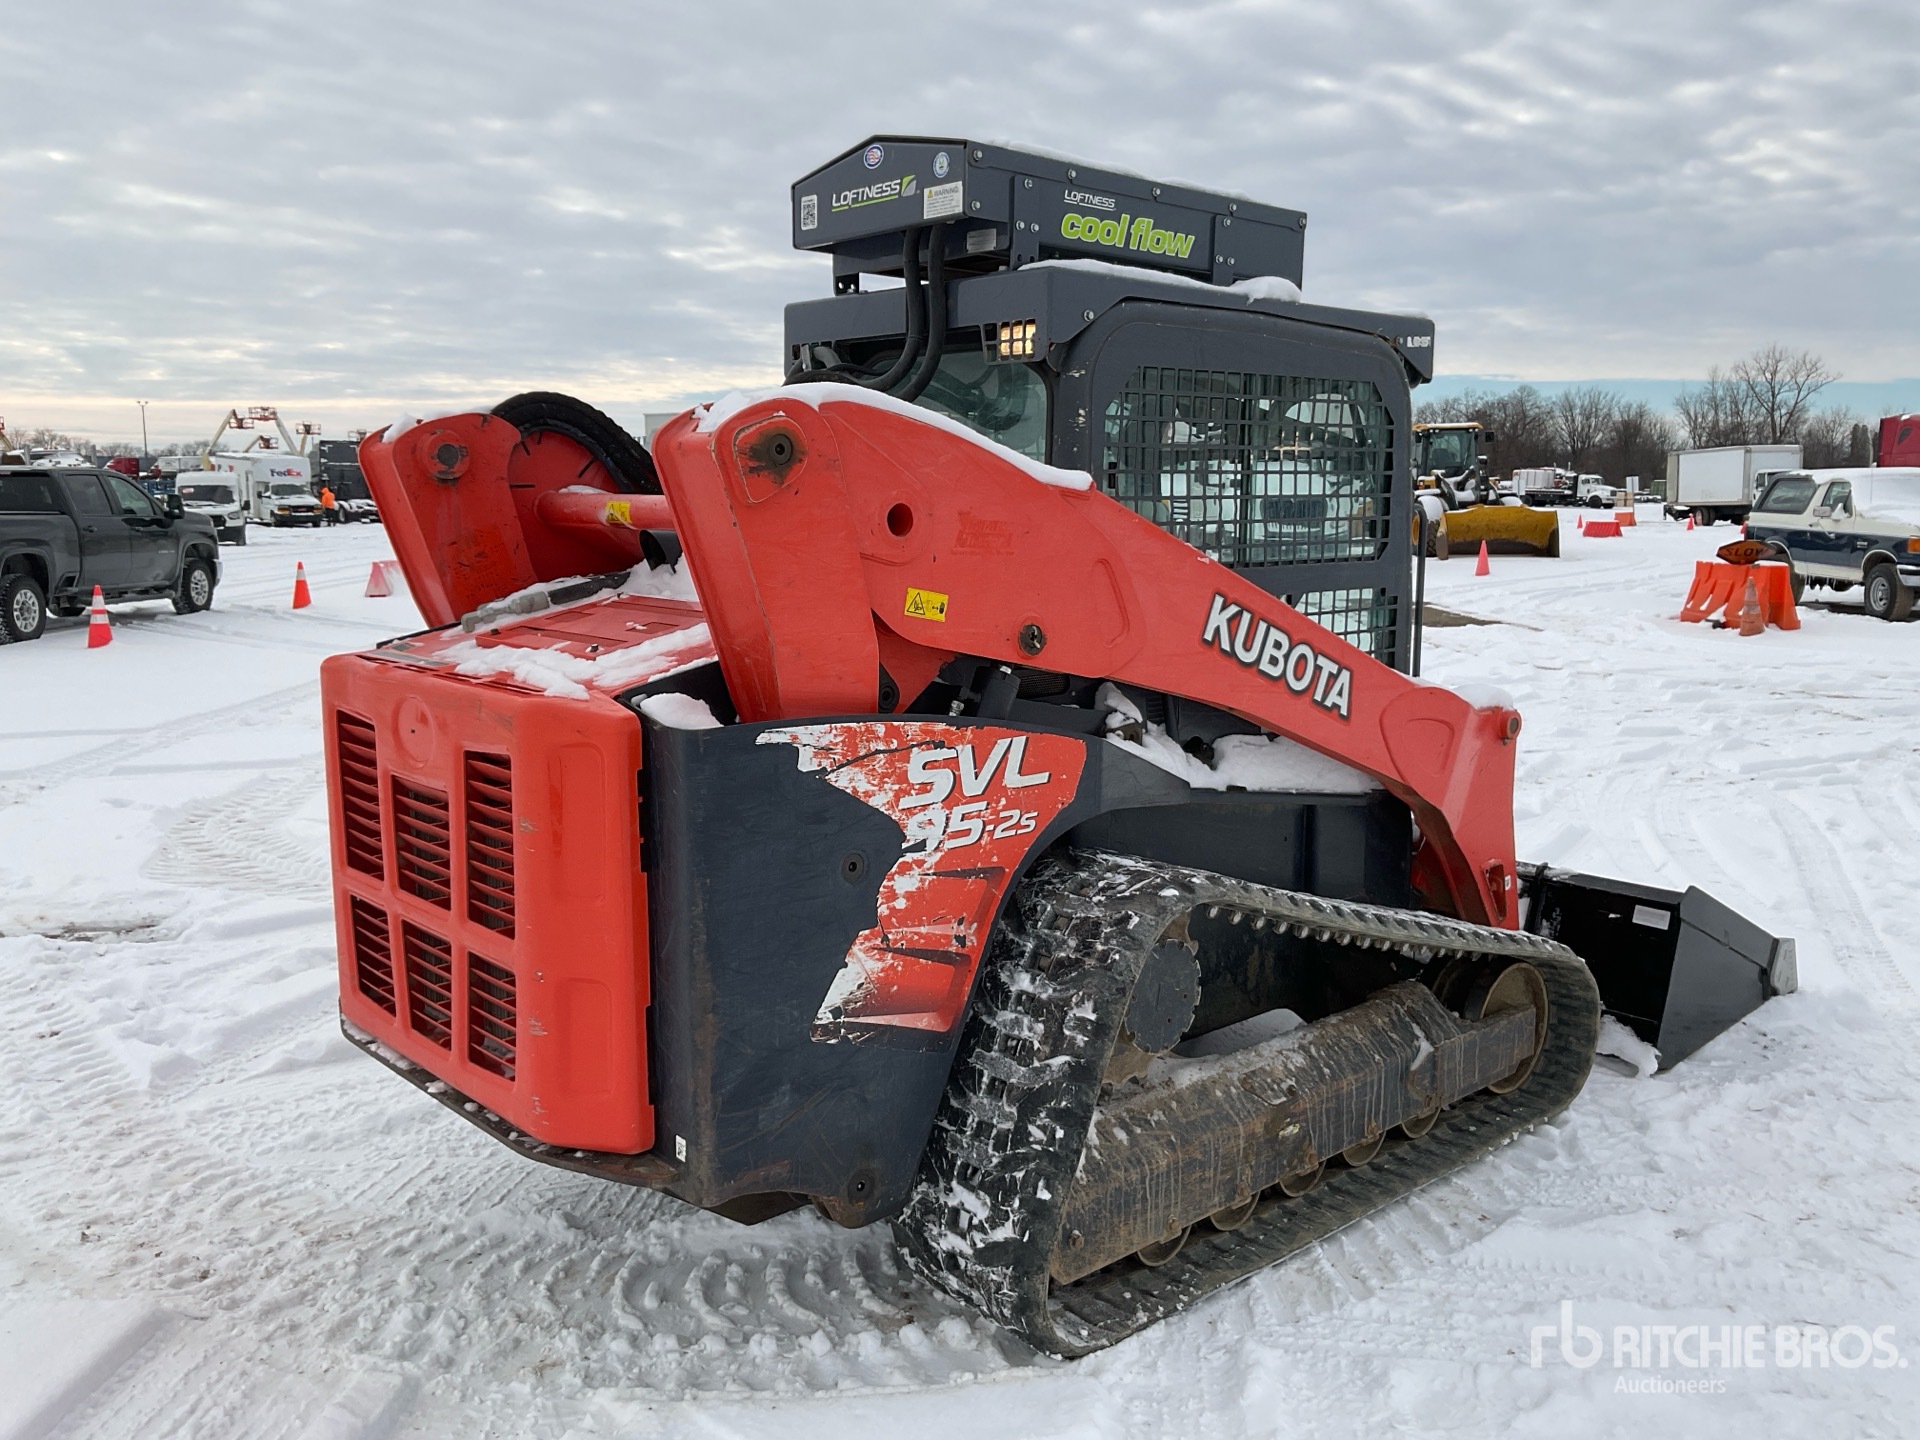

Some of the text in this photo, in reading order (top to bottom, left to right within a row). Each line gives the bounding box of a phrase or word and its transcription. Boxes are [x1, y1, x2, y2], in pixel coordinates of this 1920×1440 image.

[832, 179, 901, 207] LOFTNESS
[1064, 189, 1116, 208] LOFTNESS
[1061, 213, 1195, 258] cool flow
[269, 467, 303, 477] FedEx
[1202, 592, 1352, 717] KUBOTA
[899, 735, 1053, 811] SVL
